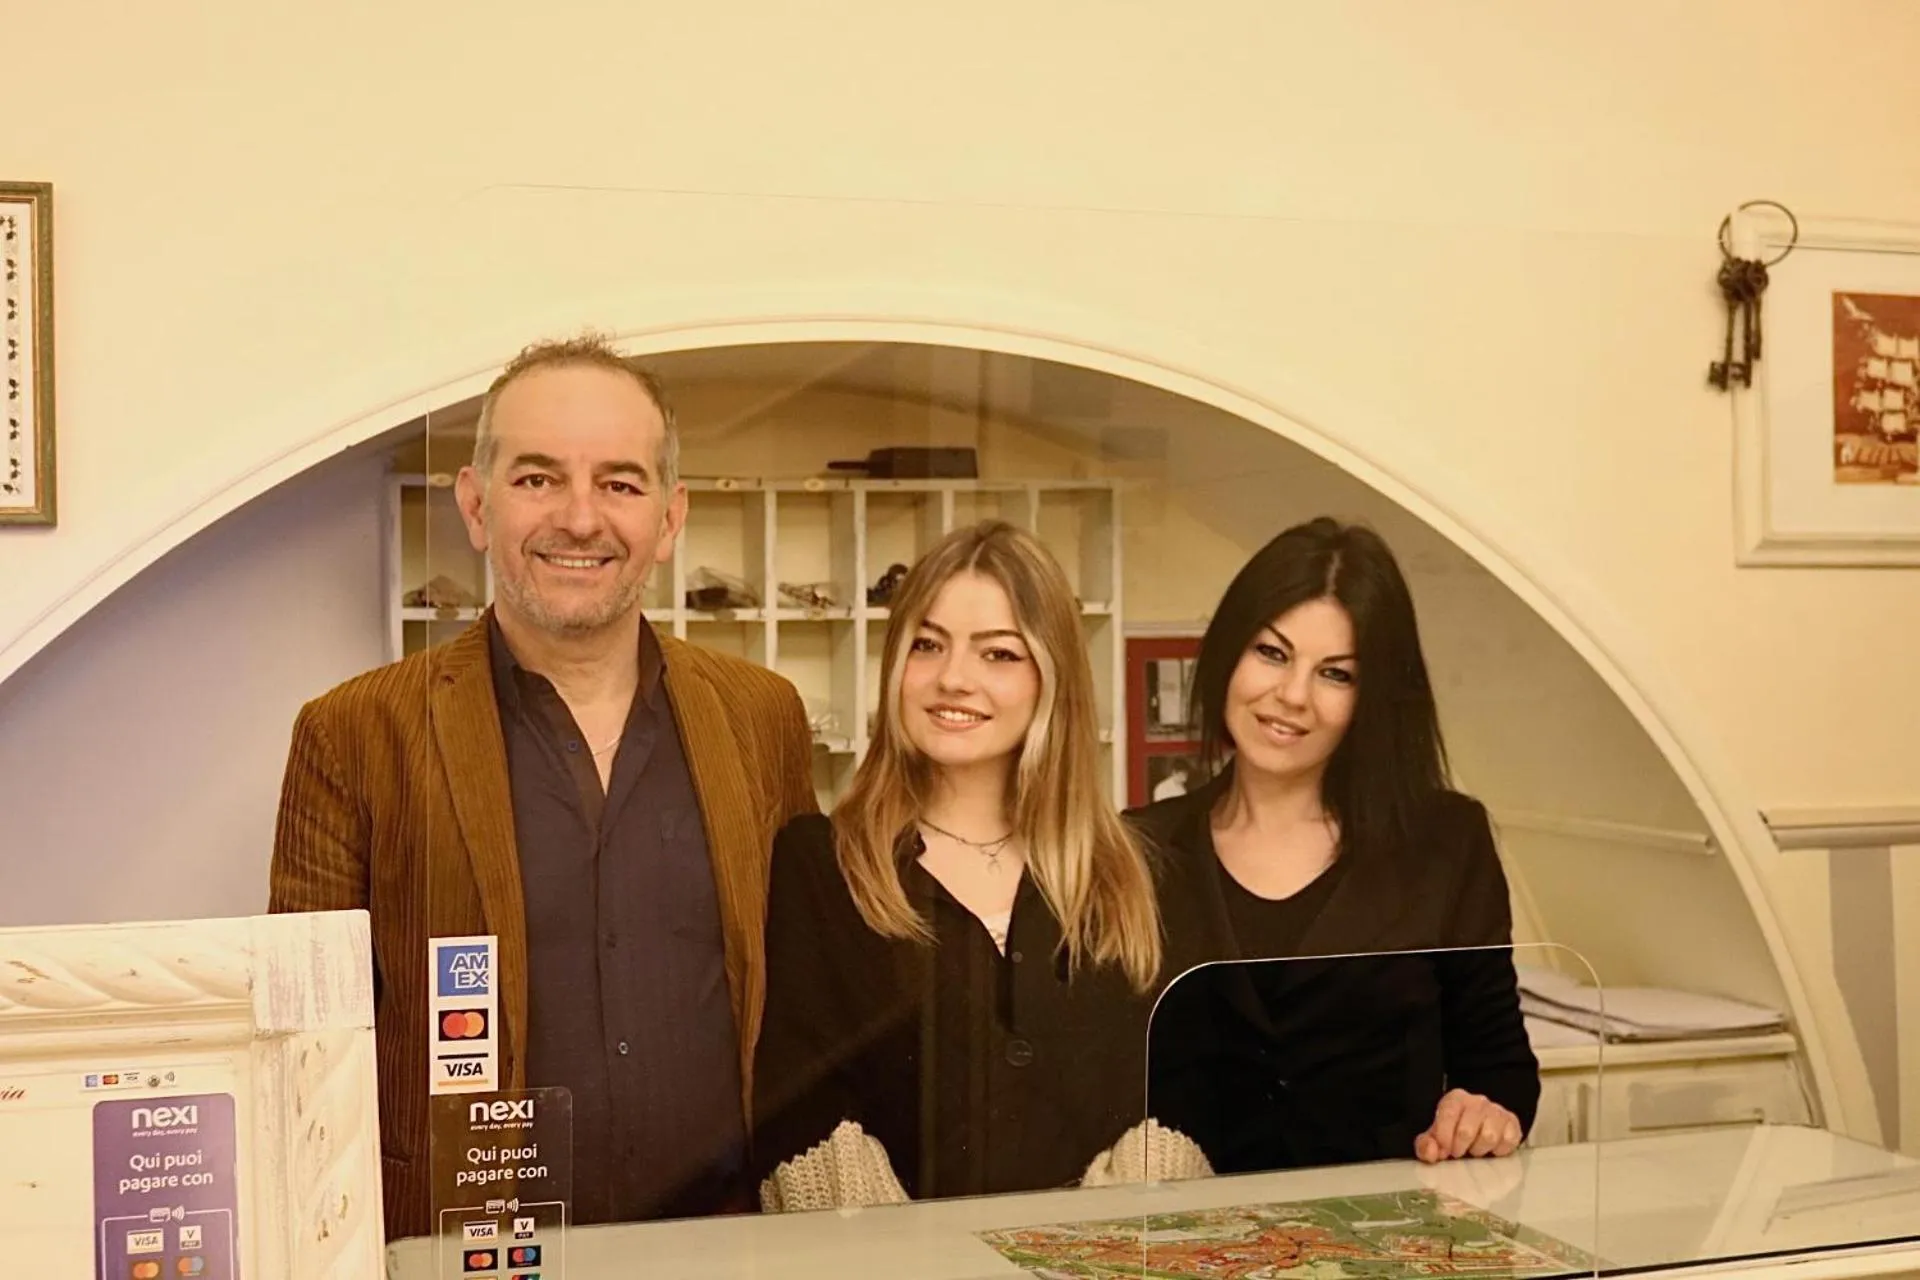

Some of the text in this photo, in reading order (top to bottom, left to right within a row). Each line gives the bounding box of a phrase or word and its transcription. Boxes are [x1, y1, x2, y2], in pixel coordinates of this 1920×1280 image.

[445, 1062, 483, 1077] VISA
[131, 1105, 198, 1129] nexi
[470, 1099, 535, 1122] nexi
[129, 1149, 202, 1172] Qui puoi
[466, 1143, 537, 1165] Qui puoi
[119, 1172, 214, 1195] pagare con
[456, 1165, 548, 1187] pagare con
[186, 1229, 195, 1239] V
[469, 1227, 494, 1237] VISA
[520, 1220, 529, 1231] V
[133, 1236, 159, 1247] VISA
